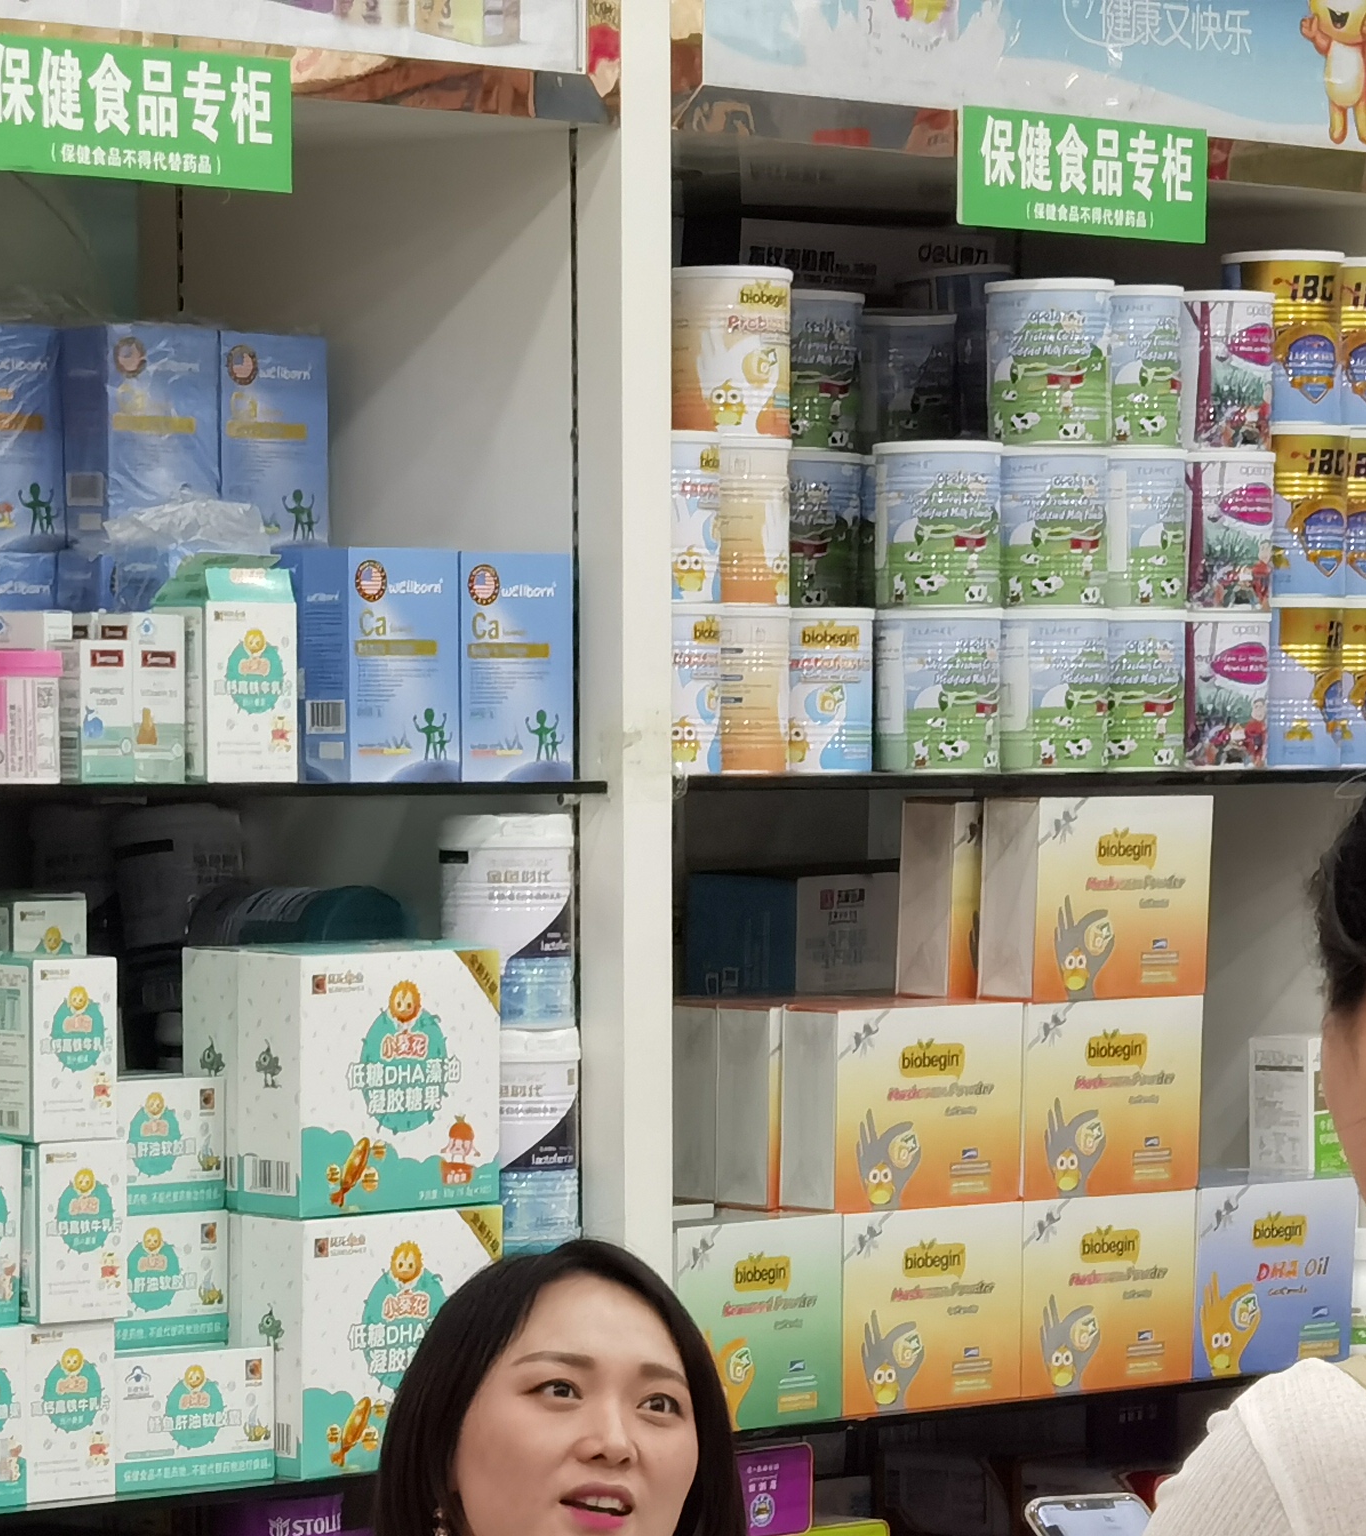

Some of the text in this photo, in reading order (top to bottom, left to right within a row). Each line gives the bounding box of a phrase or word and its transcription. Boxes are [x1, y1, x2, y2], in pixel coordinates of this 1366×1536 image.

[1099, 2, 1252, 56] 健康又快乐
[980, 114, 1194, 202] 保健食品专柜
[388, 580, 443, 596] wellborn
[501, 584, 555, 599] wellborn
[358, 609, 387, 637] Ca
[471, 613, 499, 641] Ca
[1098, 840, 1152, 861] biobegin
[901, 1052, 960, 1071] biobegin
[1088, 1042, 1142, 1060] biobegin
[346, 1055, 462, 1091] 低糖DHA藻油
[367, 1085, 442, 1115] 凝胶糖果
[1253, 1224, 1302, 1241] biobegin
[1081, 1240, 1135, 1256] biobegin
[905, 1252, 960, 1271] biobegin
[1305, 1256, 1330, 1277] Oil
[735, 1265, 786, 1284] biobegin
[383, 1290, 430, 1321] 小葵花
